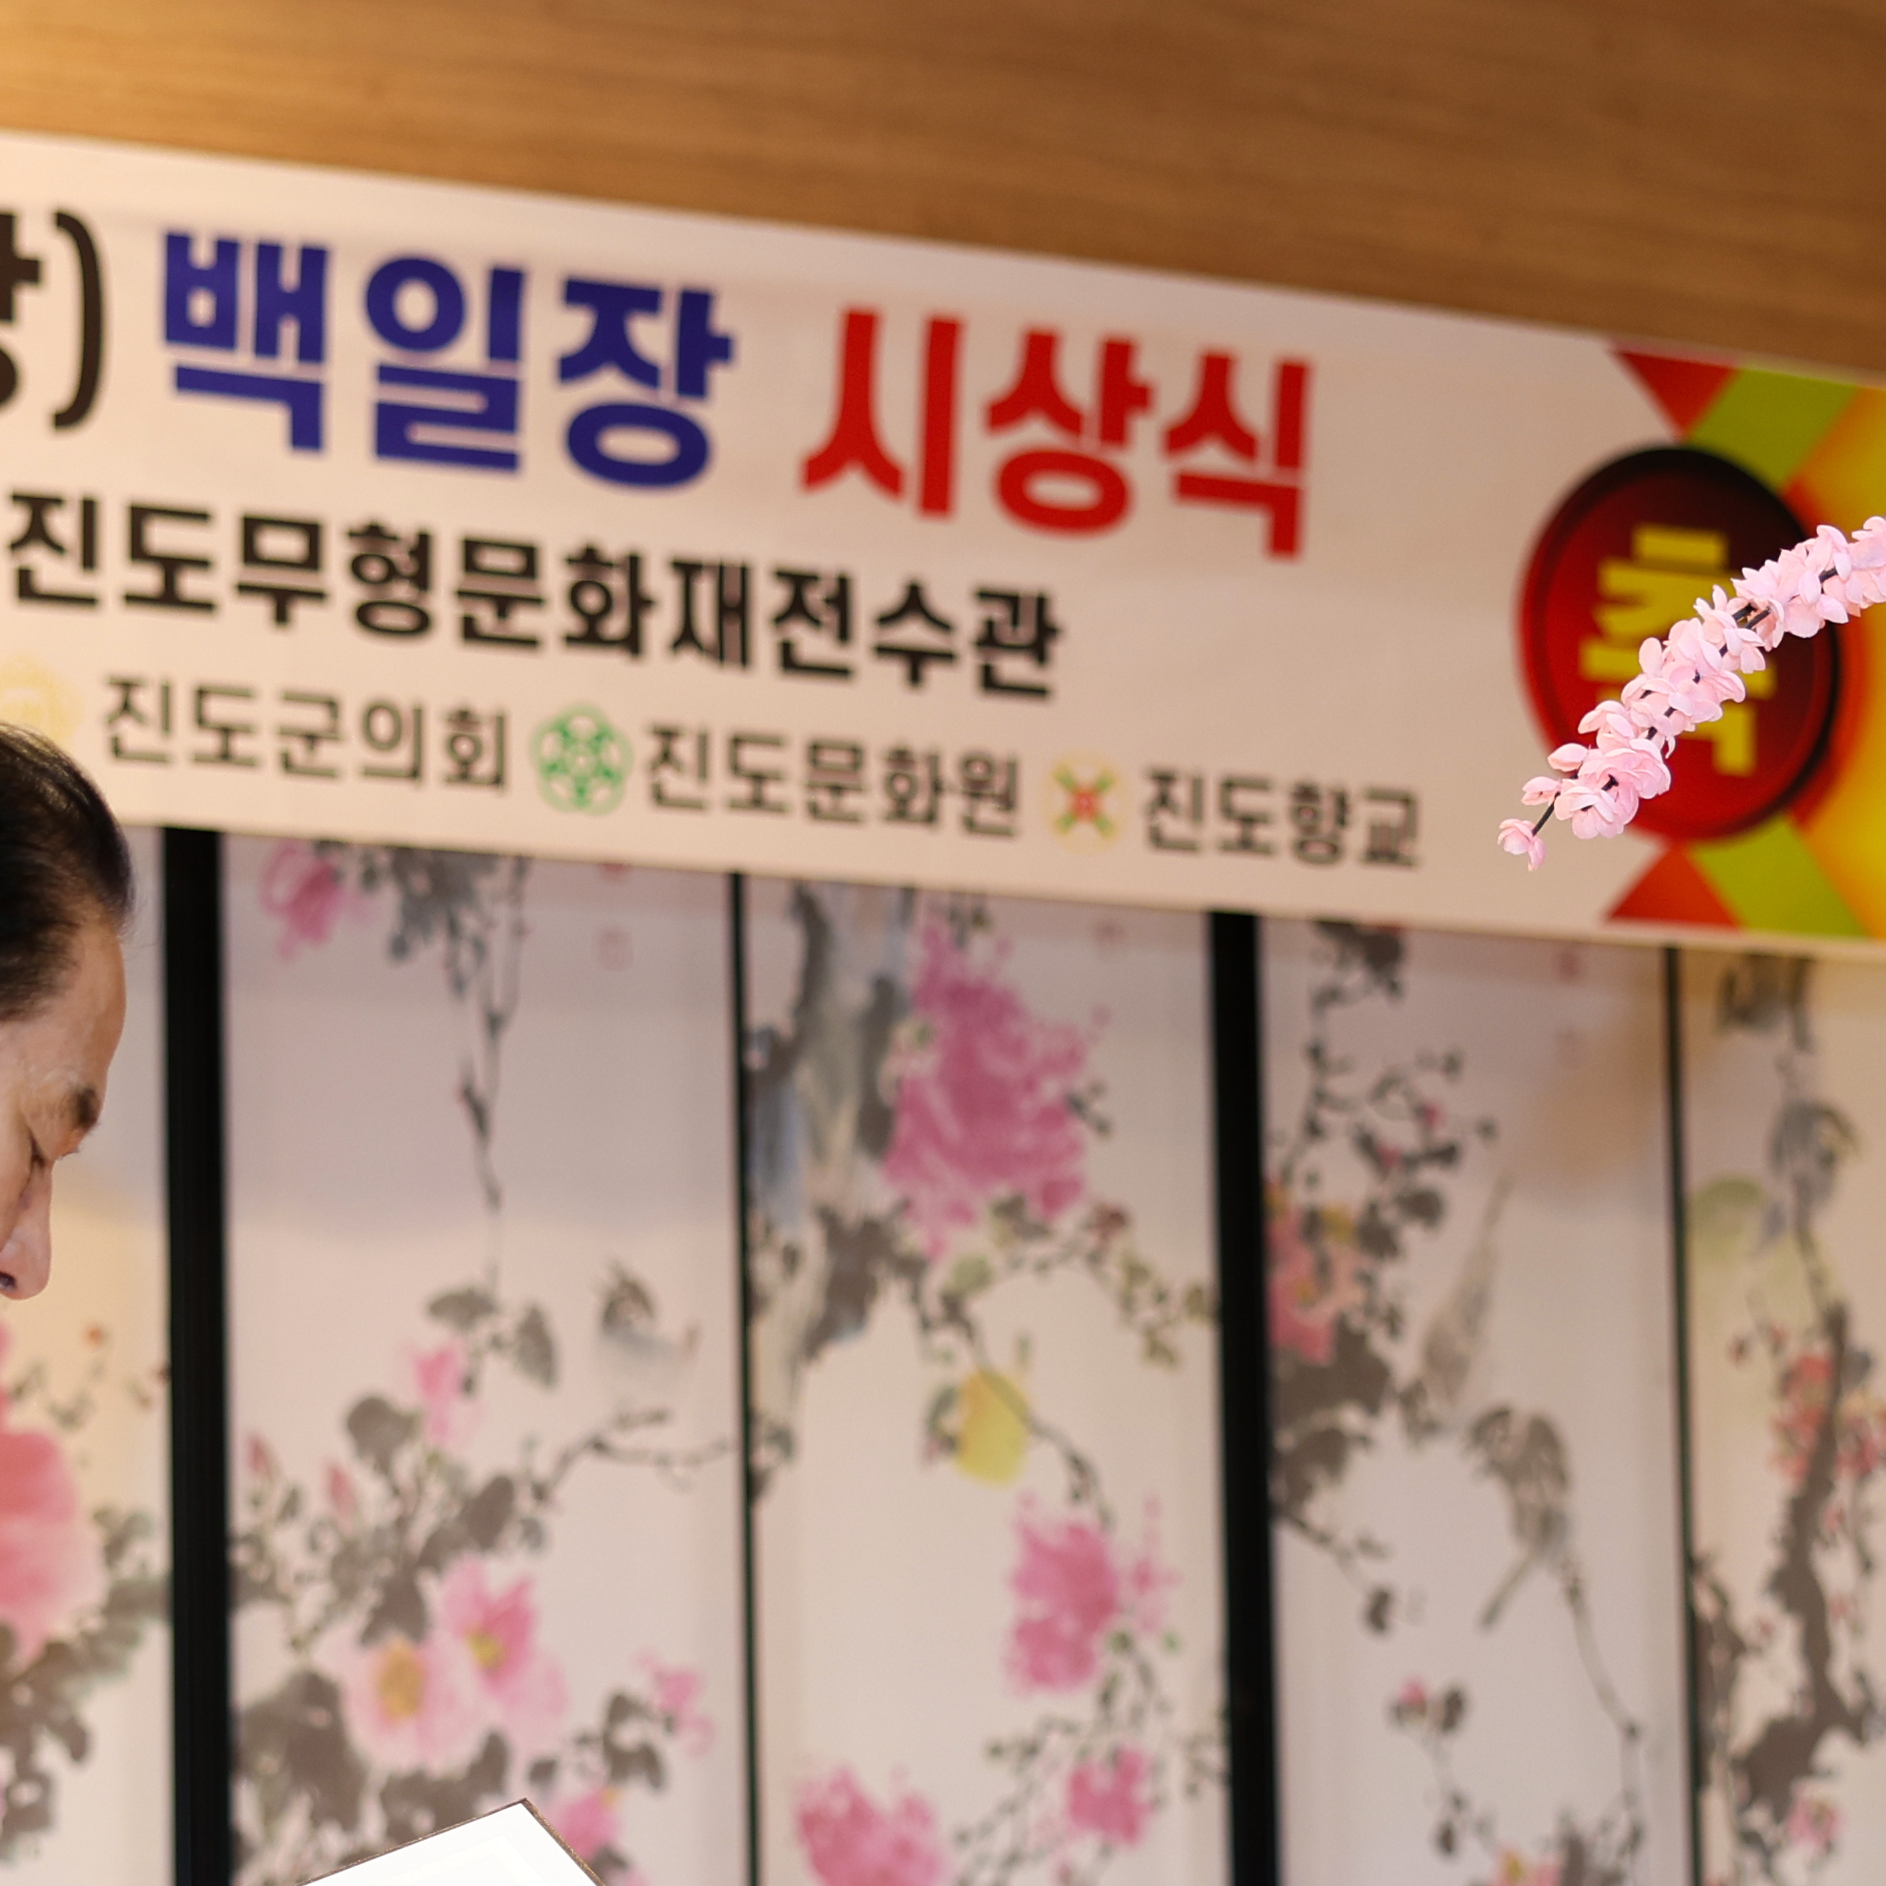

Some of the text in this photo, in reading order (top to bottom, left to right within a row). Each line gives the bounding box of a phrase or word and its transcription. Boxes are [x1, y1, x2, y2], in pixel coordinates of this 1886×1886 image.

[160, 227, 736, 492] 백일장
[799, 305, 1312, 561] 시상식
[6, 490, 1062, 701] 진도무형문화재전수관
[103, 677, 509, 794] 진도군의회
[650, 725, 1017, 837] 진도문화원
[1149, 770, 1420, 870] 진도향교
